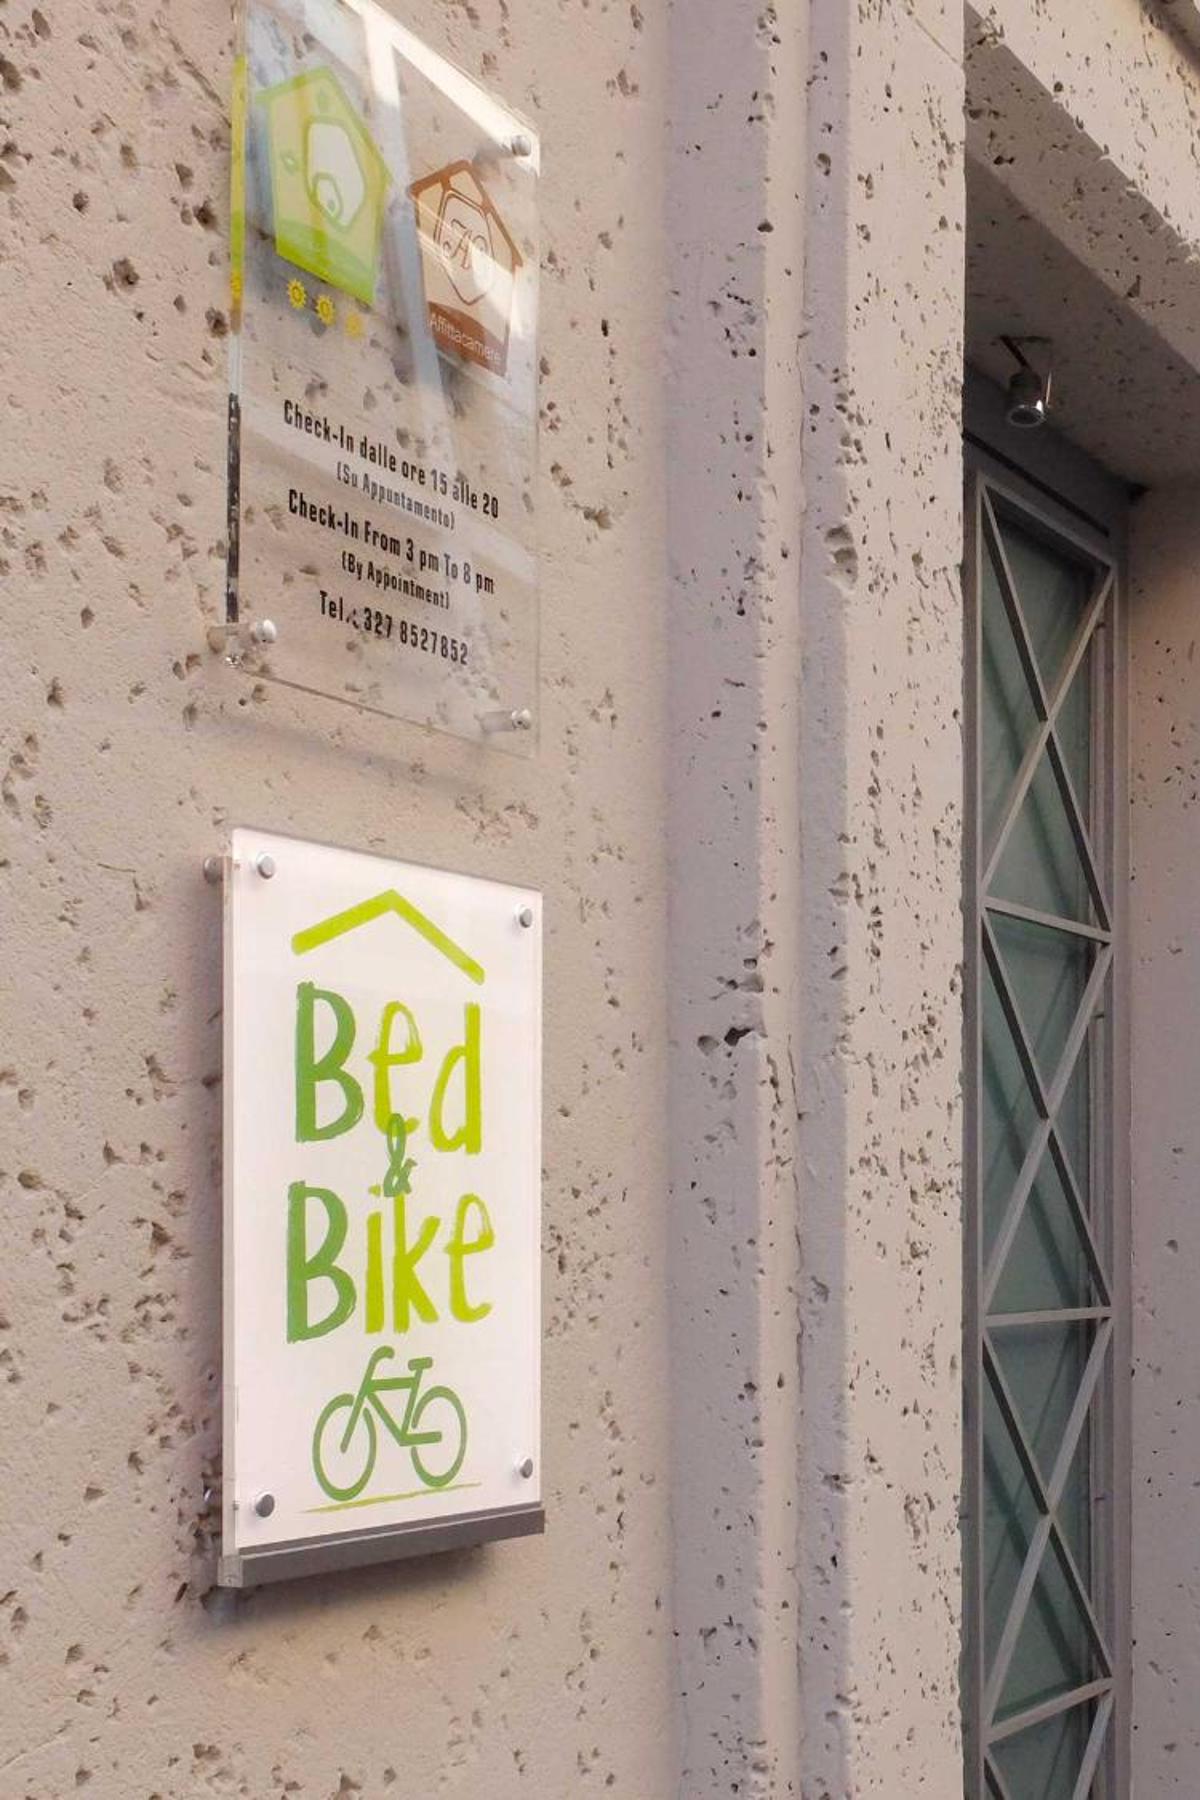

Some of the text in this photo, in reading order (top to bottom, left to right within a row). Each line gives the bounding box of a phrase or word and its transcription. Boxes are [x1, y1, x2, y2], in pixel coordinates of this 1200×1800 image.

[284, 400, 499, 519] Check-In dalle ore 15 alle 20
[336, 461, 456, 530] (Su Appuntamento)
[288, 489, 494, 594] Check-In From 3 pm To 8 pm
[342, 550, 450, 610] (By Appointment)
[364, 607, 393, 638] 327
[400, 619, 468, 665] 8527852
[294, 981, 482, 1156] Bed
[383, 1112, 418, 1198] &
[286, 1180, 495, 1344] Bike
